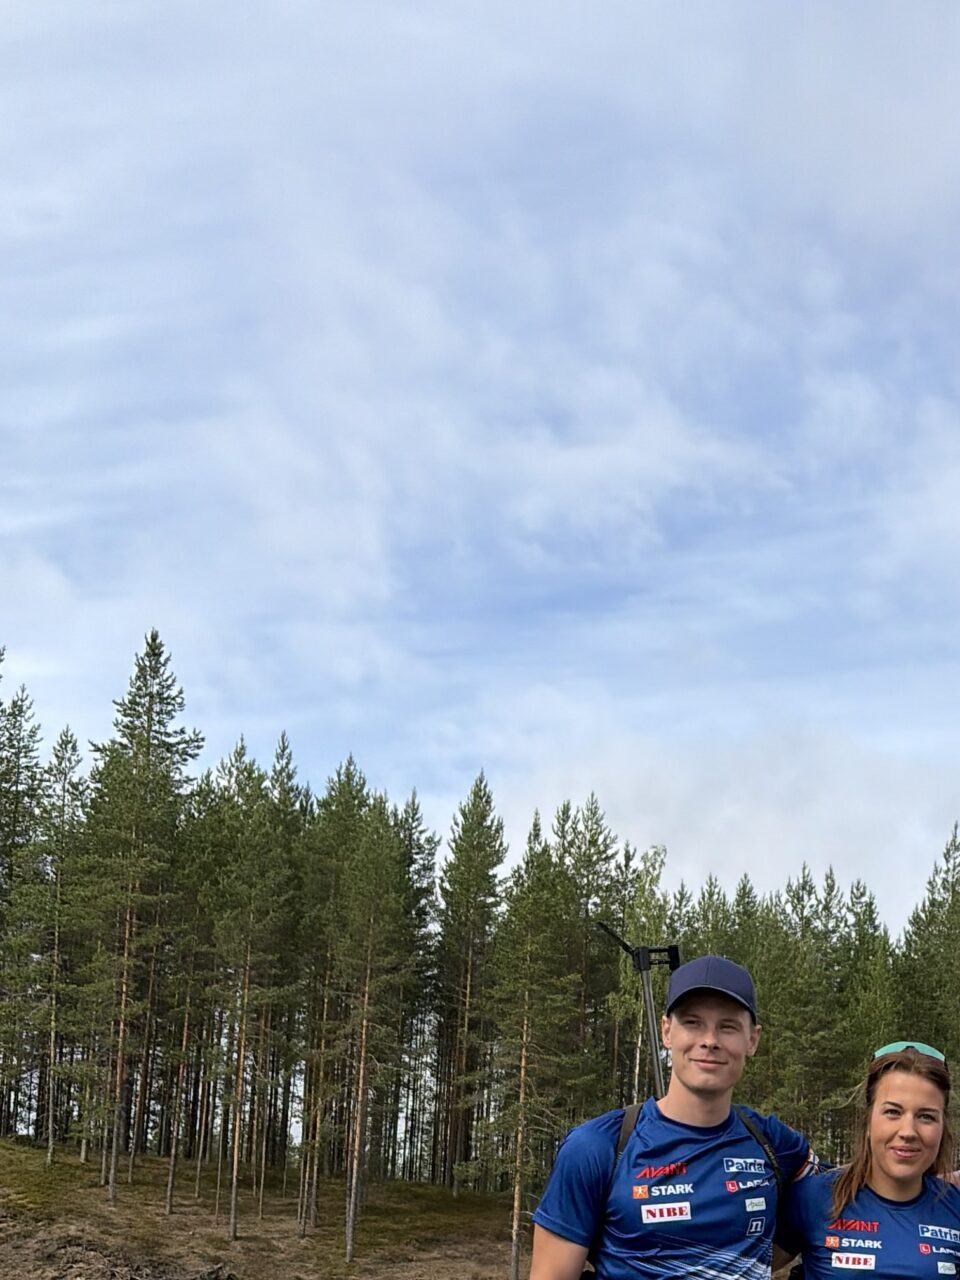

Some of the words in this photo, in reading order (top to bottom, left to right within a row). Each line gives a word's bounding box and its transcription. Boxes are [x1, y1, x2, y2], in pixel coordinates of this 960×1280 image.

[635, 1161, 687, 1179] AVANT
[725, 1159, 764, 1171] Patria
[651, 1183, 694, 1196] STARK
[645, 1206, 688, 1219] NIBE
[827, 1219, 880, 1232] AVANT
[920, 1226, 959, 1242] Patria
[841, 1238, 882, 1249] STARK
[834, 1256, 873, 1266] NIBE
